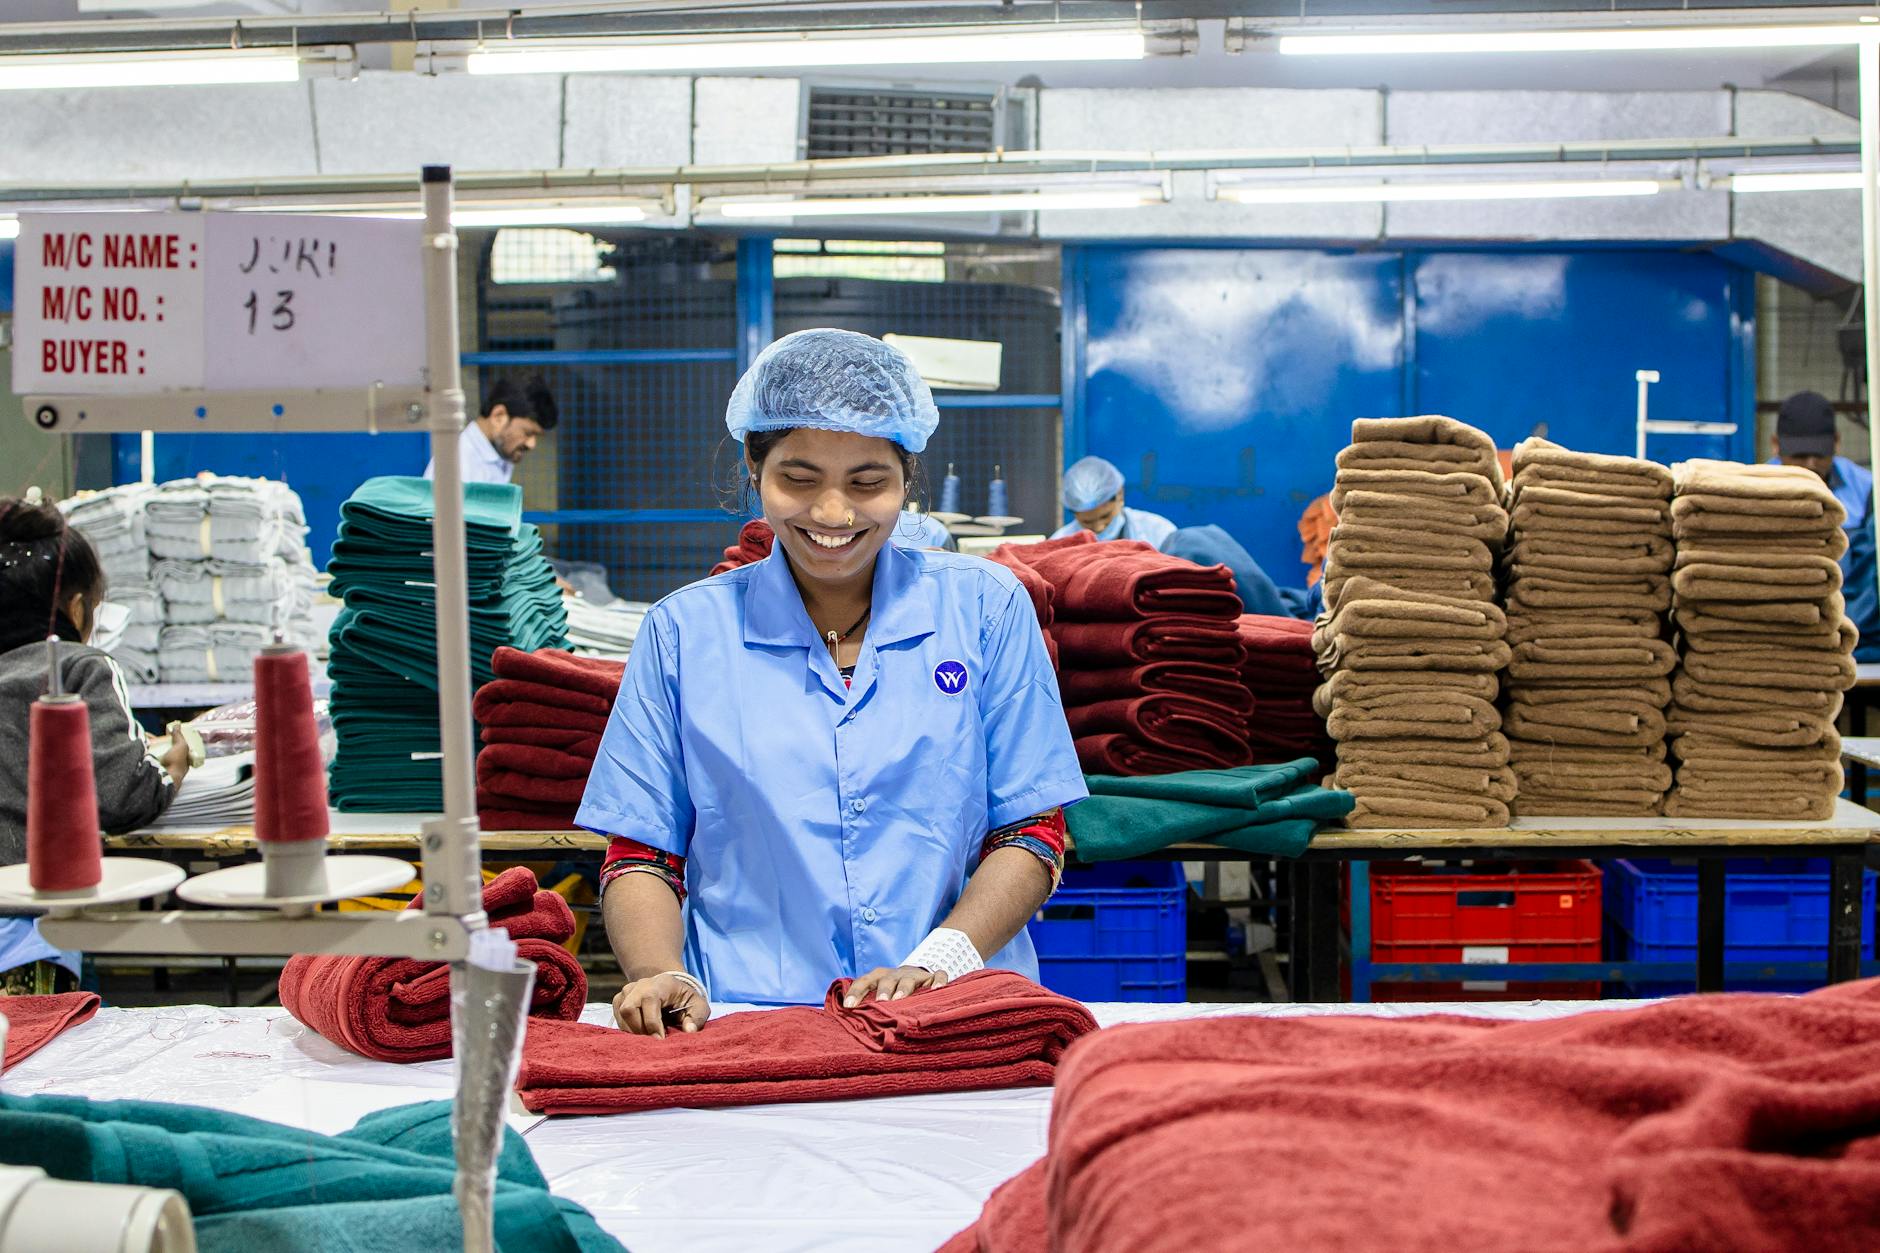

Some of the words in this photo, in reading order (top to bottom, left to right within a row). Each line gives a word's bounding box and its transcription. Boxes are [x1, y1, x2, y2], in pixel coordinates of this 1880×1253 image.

[43, 233, 92, 271] M/C
[42, 286, 92, 324] M/C
[244, 290, 295, 334] 13
[937, 671, 966, 688] W
